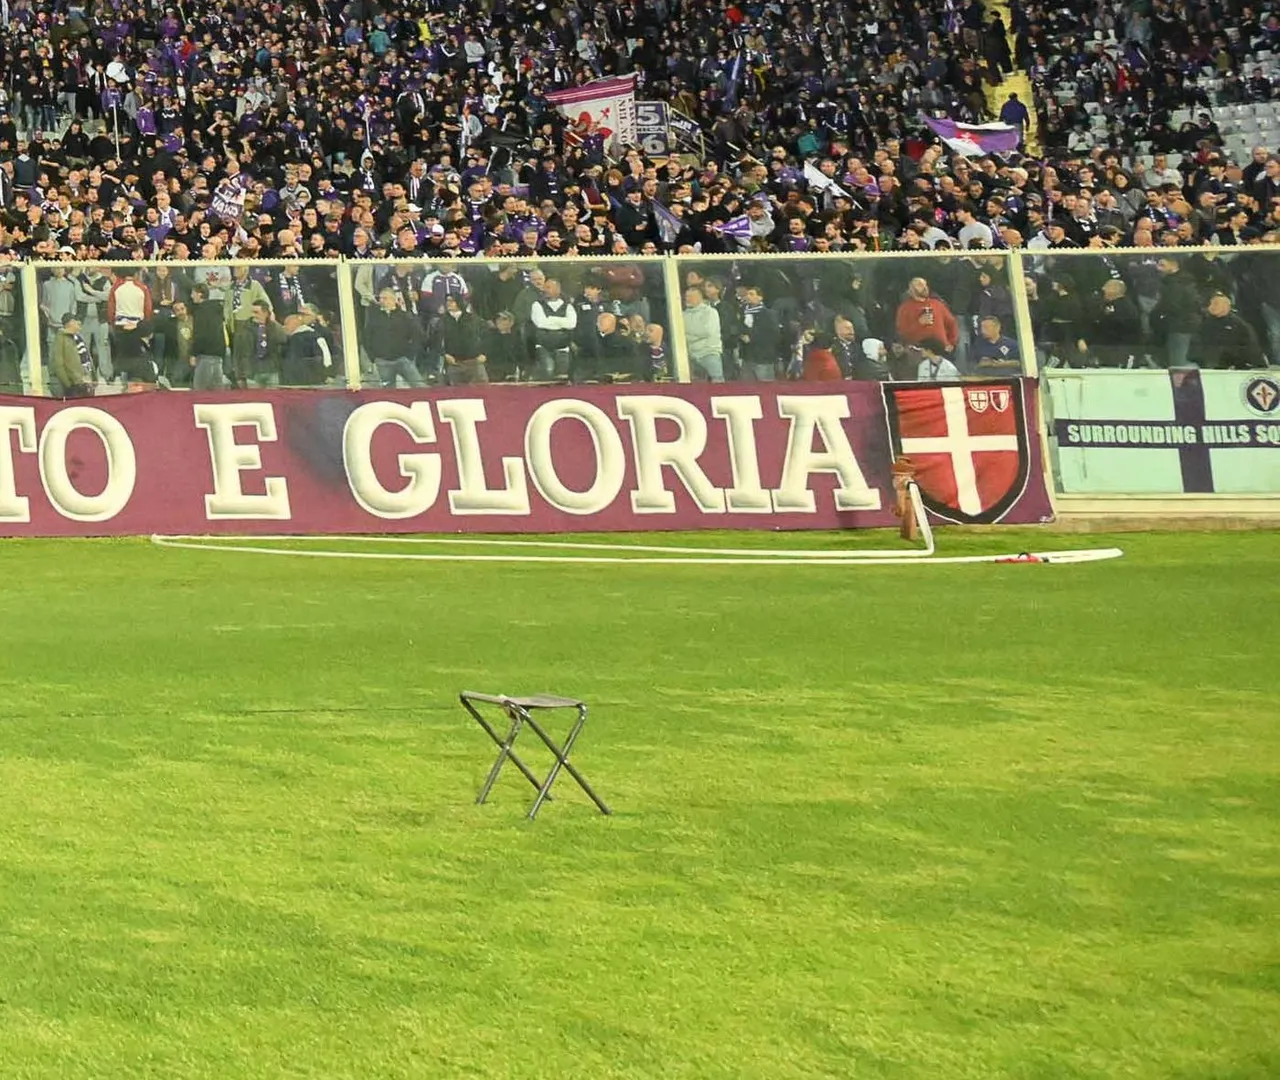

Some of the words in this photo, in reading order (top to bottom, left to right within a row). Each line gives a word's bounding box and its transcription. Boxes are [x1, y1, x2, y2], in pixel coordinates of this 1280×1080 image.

[636, 106, 661, 125] 5
[642, 134, 666, 154] 6
[1067, 423, 1197, 444] SURROUNDING
[1201, 424, 1251, 444] HILLS
[1255, 424, 1280, 445] SQ
[192, 402, 292, 521] E
[342, 394, 882, 520] GLORIA
